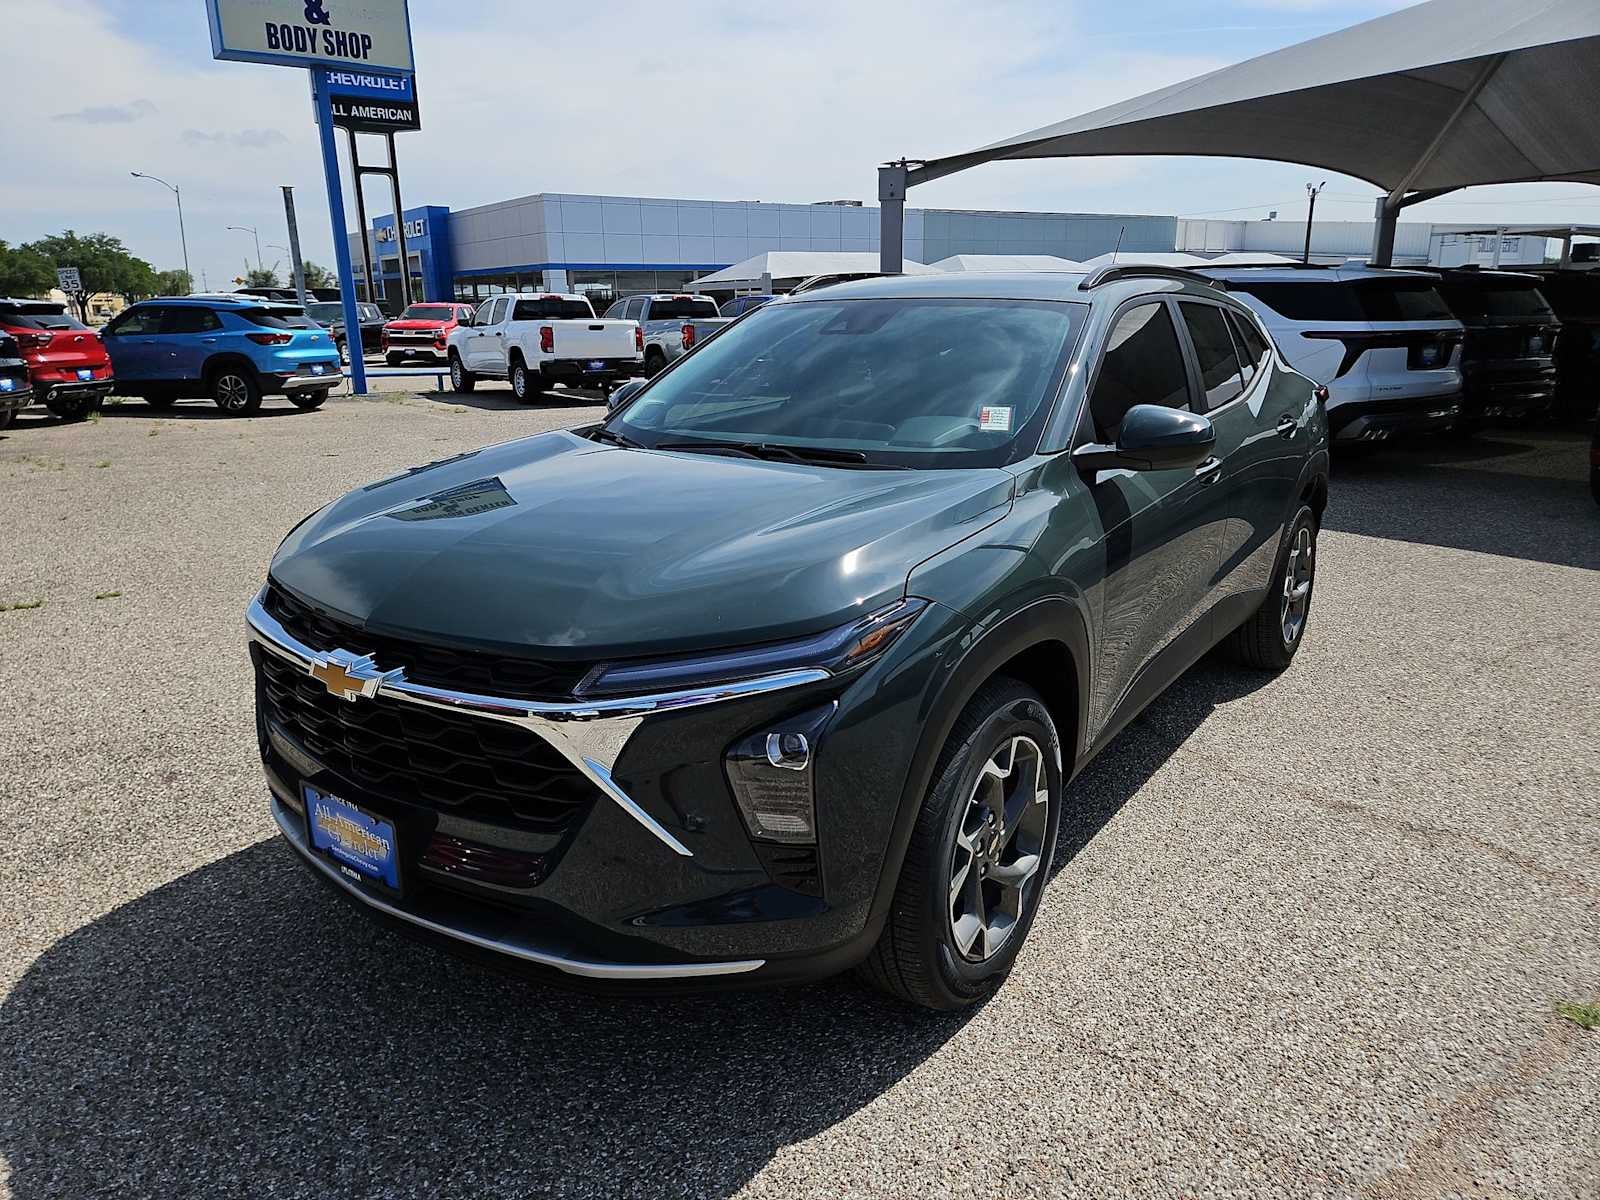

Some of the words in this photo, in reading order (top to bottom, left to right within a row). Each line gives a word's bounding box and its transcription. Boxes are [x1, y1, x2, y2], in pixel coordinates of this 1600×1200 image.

[304, 0, 331, 25] &
[265, 22, 317, 53] BODY
[322, 29, 372, 59] SHOP
[331, 103, 348, 117] LL
[350, 105, 413, 121] AMERICAN
[386, 218, 425, 241] CHROLET
[62, 280, 79, 290] 35
